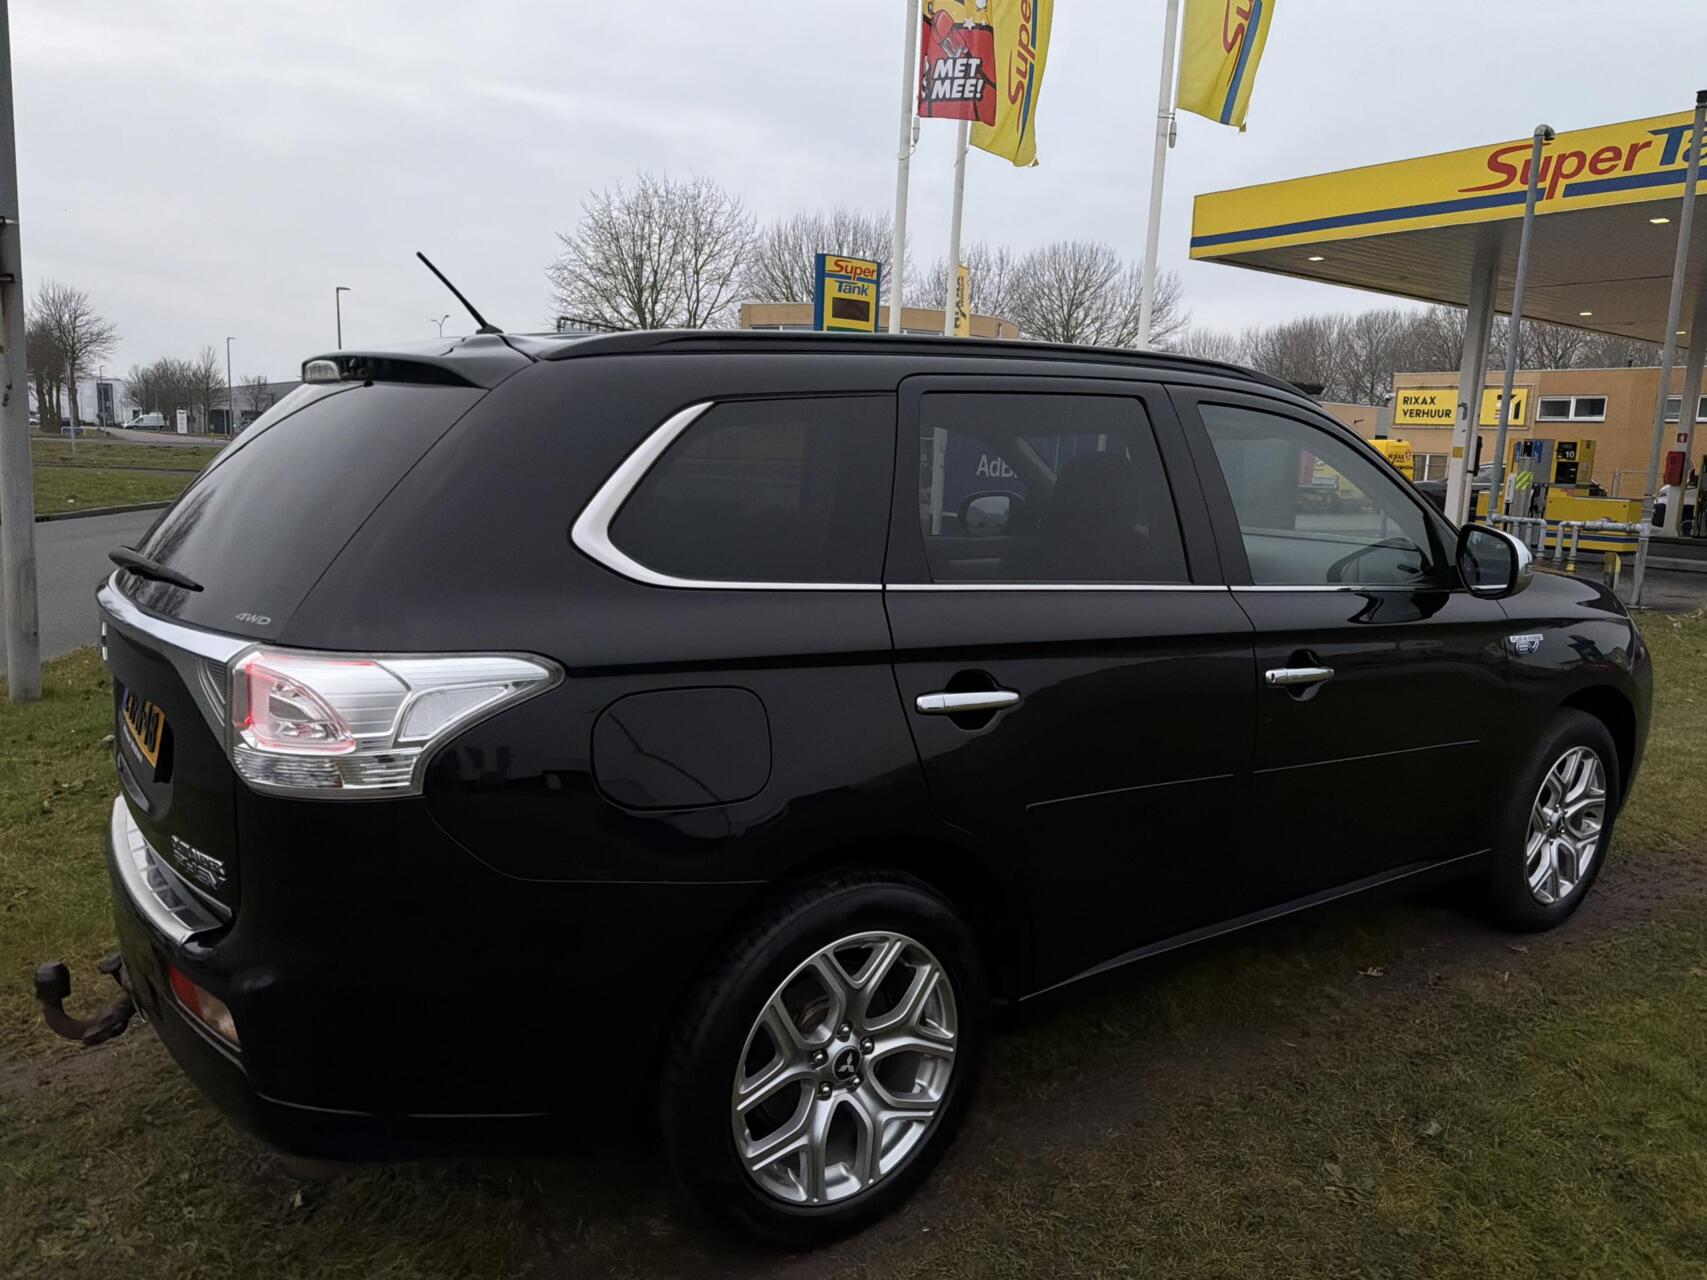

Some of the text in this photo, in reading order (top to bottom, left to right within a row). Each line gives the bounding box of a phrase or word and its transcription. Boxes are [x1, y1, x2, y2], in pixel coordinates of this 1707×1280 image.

[933, 58, 982, 79] MET
[931, 79, 984, 99] MEE!
[825, 258, 877, 281] Super
[834, 279, 869, 297] Tank
[1402, 396, 1437, 406] RIXAX
[1402, 408, 1452, 419] VERHUUR
[235, 613, 272, 625] 4WD
